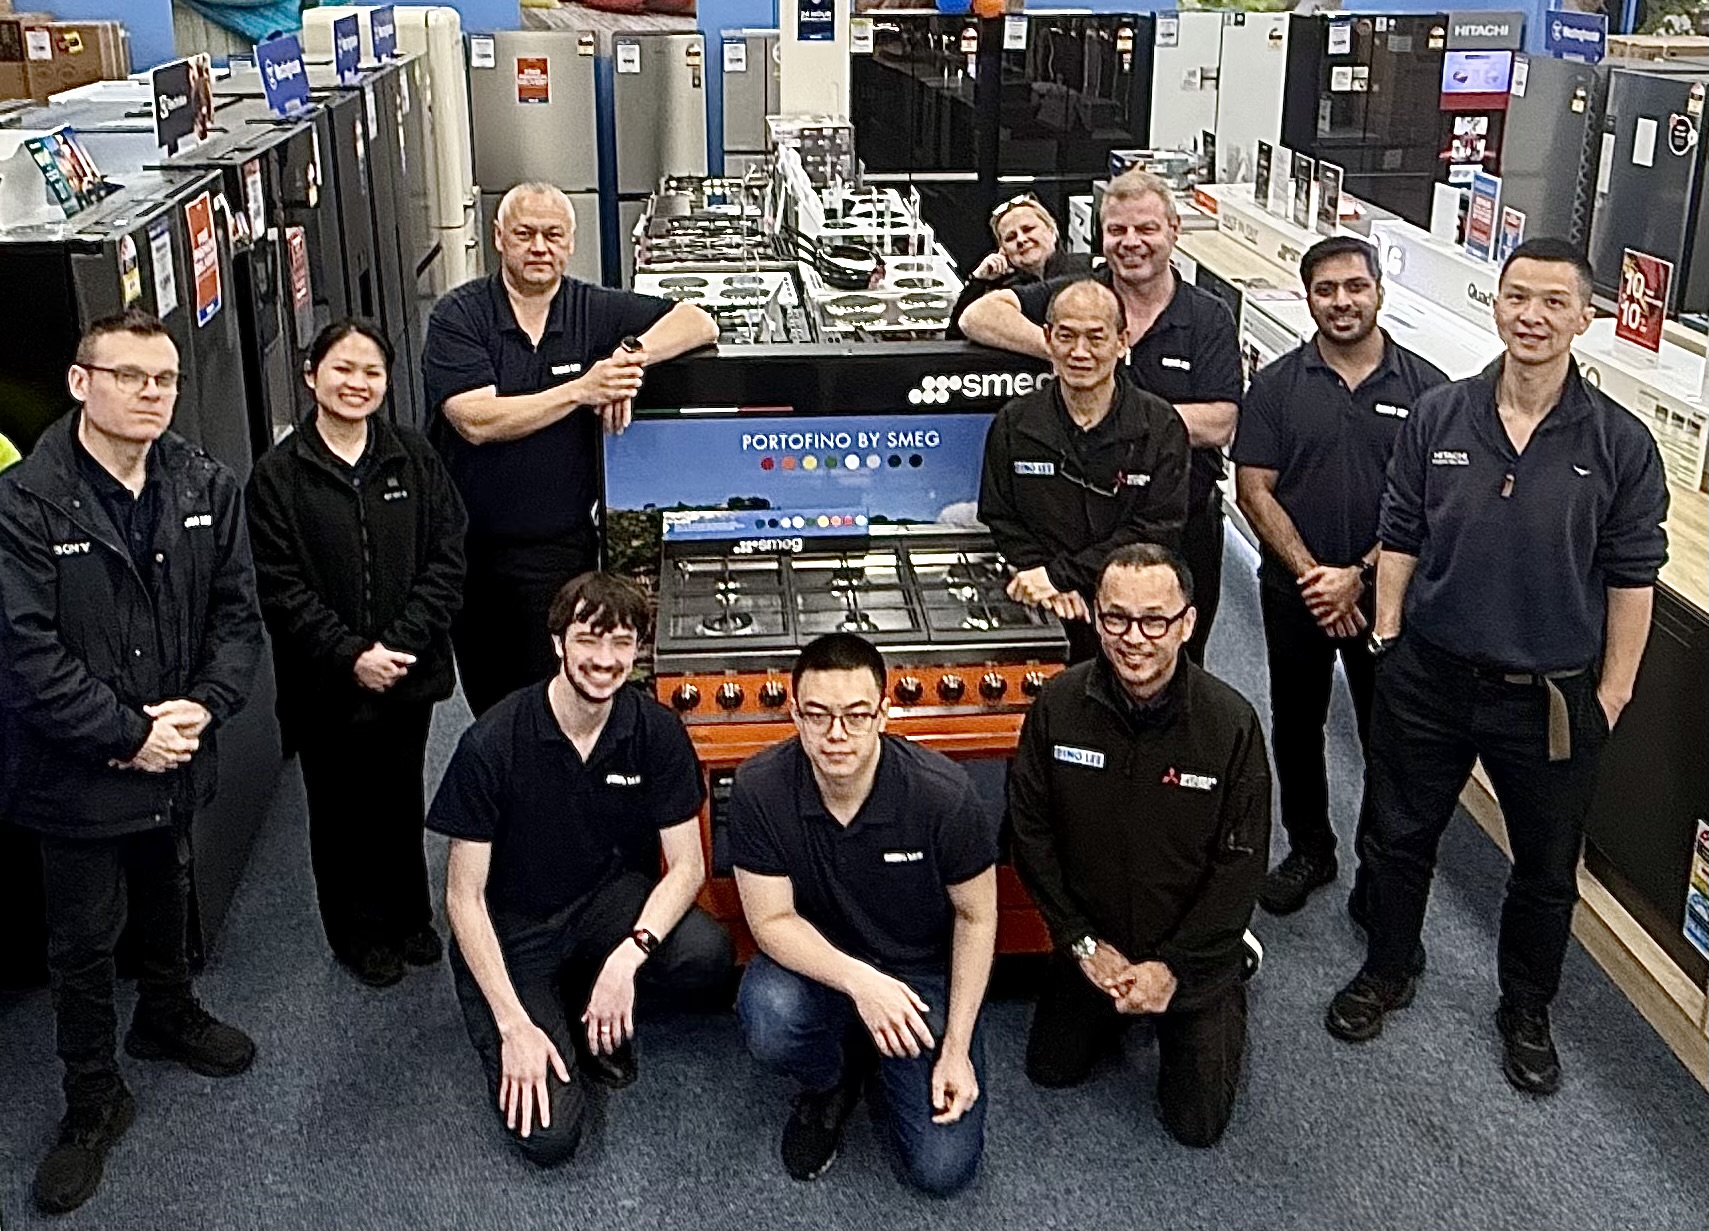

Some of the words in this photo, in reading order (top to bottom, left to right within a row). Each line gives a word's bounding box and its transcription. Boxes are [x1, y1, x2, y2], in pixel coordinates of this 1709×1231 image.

[1454, 24, 1509, 37] HITACHI
[1625, 271, 1645, 299] 10
[1620, 300, 1641, 330] 10
[742, 432, 852, 450] PORTOFINO
[858, 432, 880, 448] BY
[887, 430, 941, 448] SMEG
[53, 541, 91, 555] SONY
